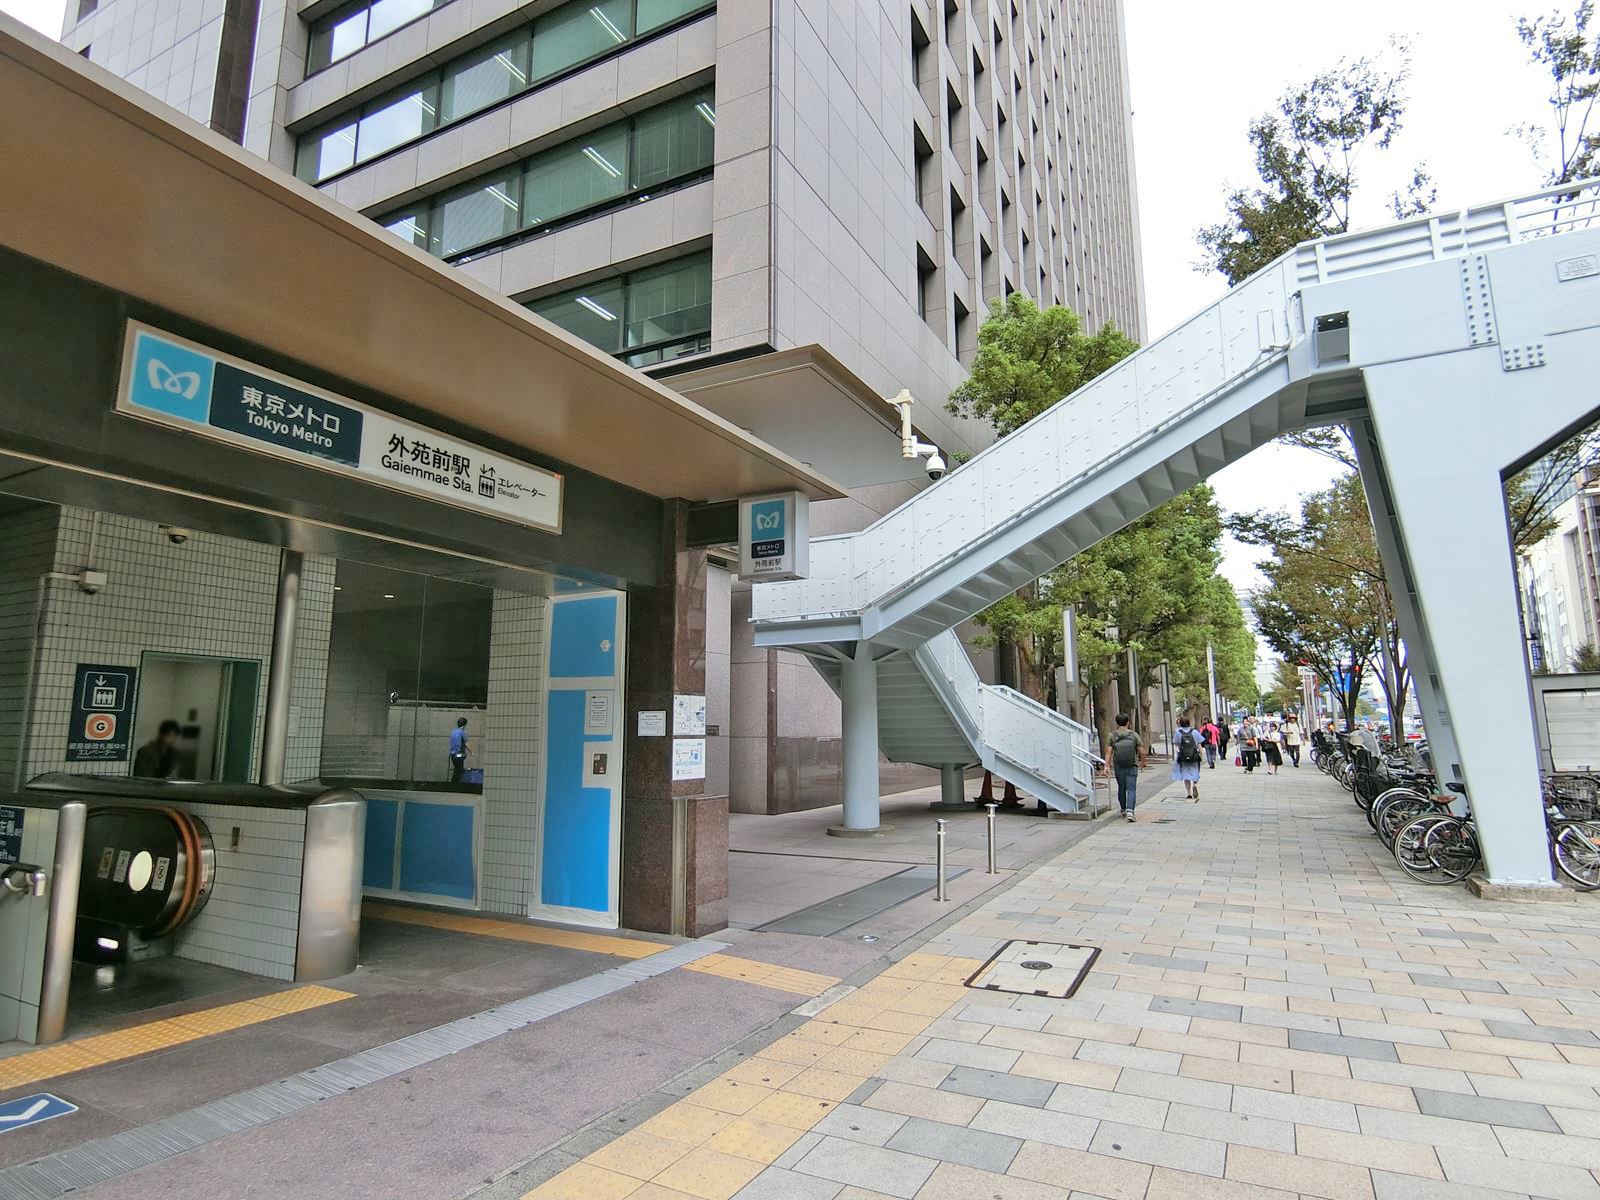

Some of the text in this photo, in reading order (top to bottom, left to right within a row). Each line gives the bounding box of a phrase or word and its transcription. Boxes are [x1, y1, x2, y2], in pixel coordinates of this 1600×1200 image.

[241, 386, 341, 434] 東京メトロ
[246, 409, 333, 448] Tokyo Metro
[388, 433, 470, 478] 外苑前駅
[381, 454, 474, 494] Gaiemmae Sta.
[498, 477, 546, 498] エレベーター
[497, 487, 520, 500] Elevator
[754, 558, 782, 568] 外苑前駅
[96, 722, 106, 731] G
